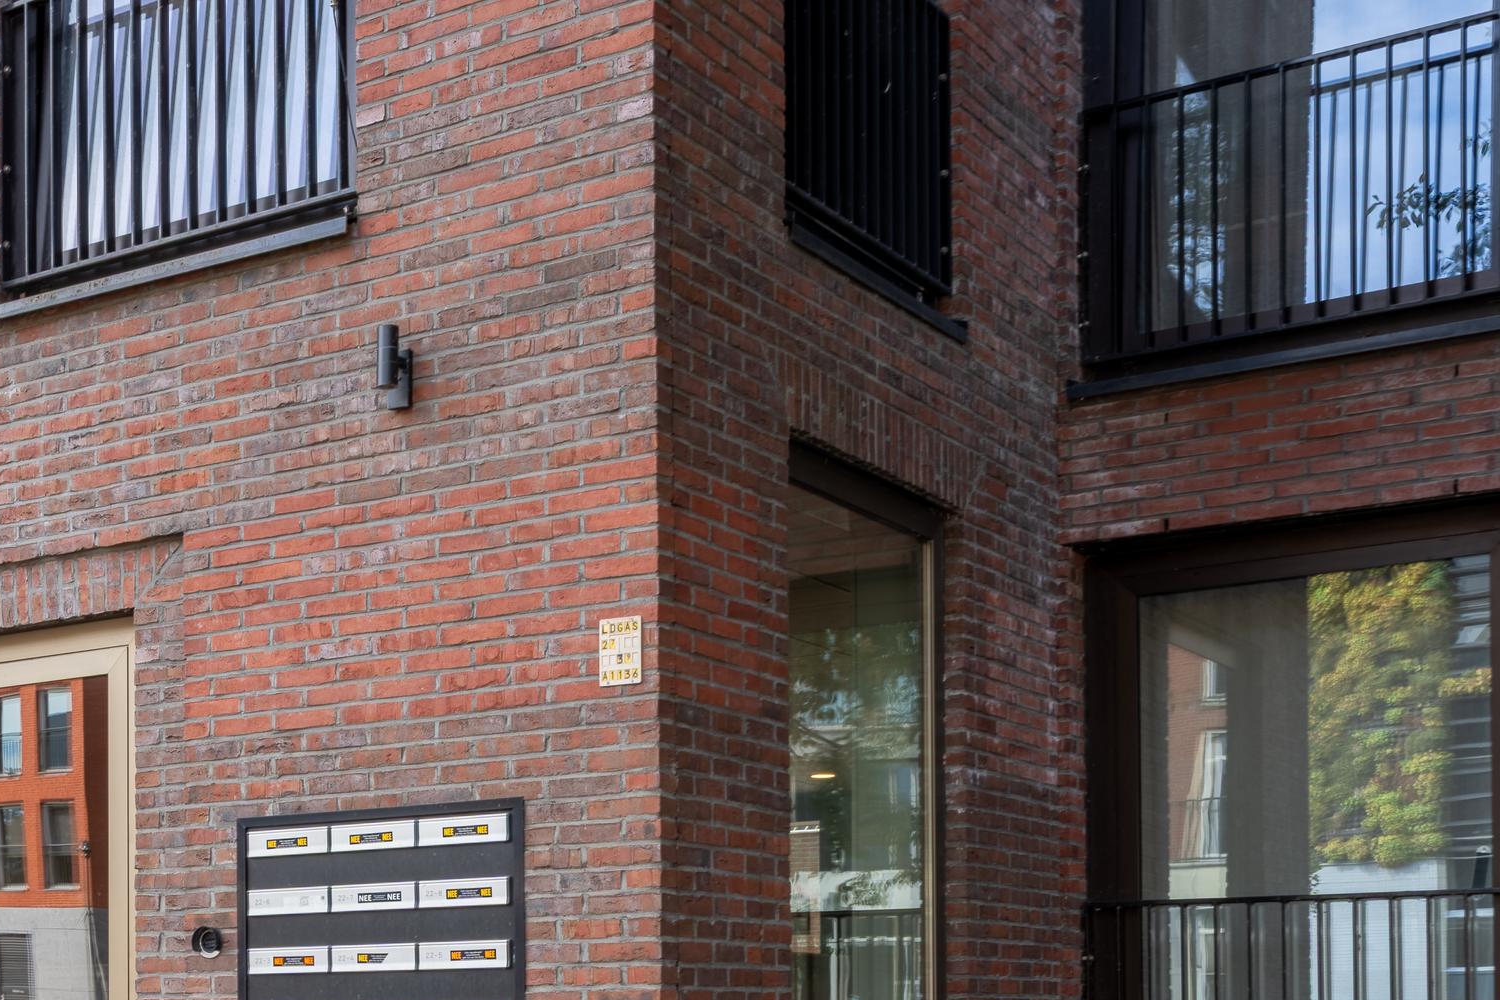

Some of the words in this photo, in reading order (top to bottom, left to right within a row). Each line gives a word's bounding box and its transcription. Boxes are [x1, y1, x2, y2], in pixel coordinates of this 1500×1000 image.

[601, 621, 639, 634] LDGAS
[602, 668, 639, 681] A1136
[443, 828, 454, 837] NEE
[477, 825, 488, 834] NEE
[268, 840, 277, 849] NEE
[297, 838, 307, 847] NEE
[351, 835, 361, 844] NEE
[382, 832, 392, 841] NEE
[358, 894, 373, 902] NEE
[386, 892, 401, 901] NEE
[447, 889, 458, 899] NEE
[480, 888, 492, 897] NEE
[358, 954, 368, 963] NEE
[451, 952, 462, 961] NEE
[484, 950, 495, 959] NEE
